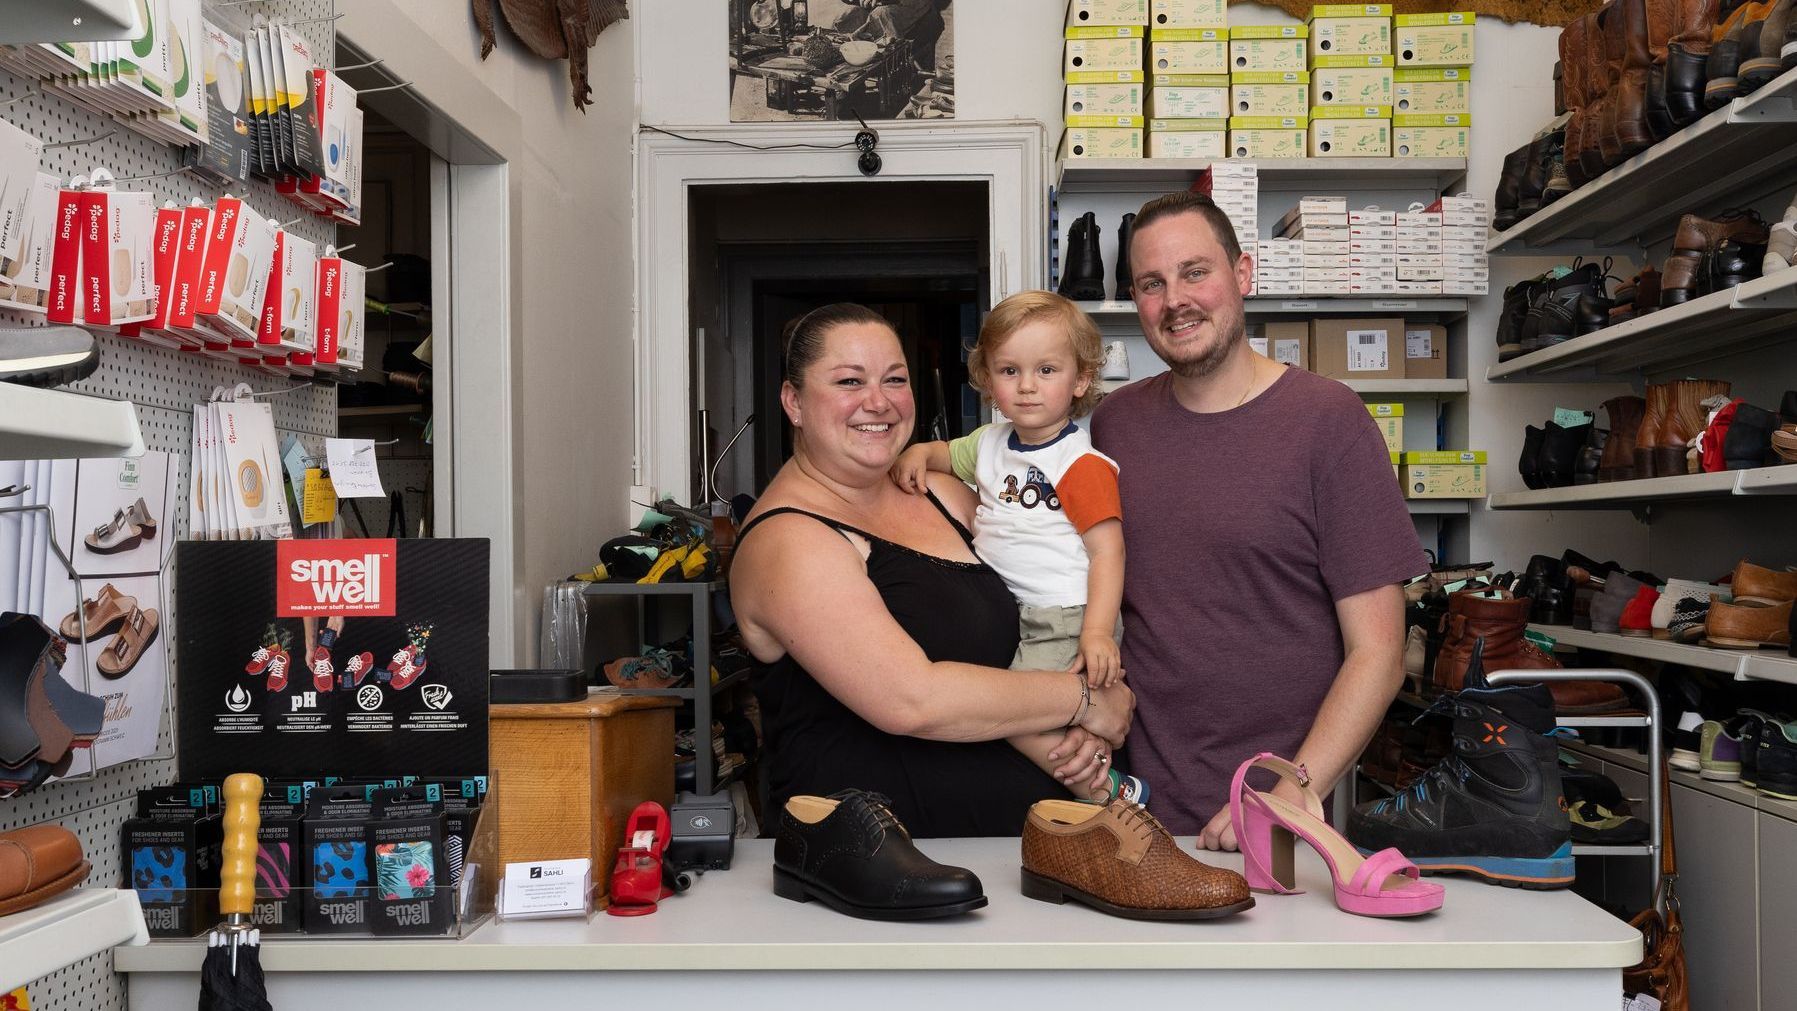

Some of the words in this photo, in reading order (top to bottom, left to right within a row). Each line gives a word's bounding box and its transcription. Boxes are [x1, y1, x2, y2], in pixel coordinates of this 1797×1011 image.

[0, 209, 13, 250] perfect
[62, 207, 73, 239] pedag
[89, 208, 100, 241] pedag
[187, 221, 198, 252] pedag
[217, 212, 229, 240] pedag
[159, 223, 170, 254] pedag
[34, 246, 42, 283] perfect
[57, 274, 66, 311] perfect
[90, 276, 101, 313] perfect
[205, 270, 217, 303] perfect
[325, 270, 333, 298] pedag
[178, 283, 189, 316] perfect
[266, 306, 274, 334] t-form
[291, 554, 380, 582] smell
[311, 580, 380, 604] well
[291, 691, 317, 712] pH
[193, 792, 200, 803] 2
[292, 789, 298, 800] 2
[430, 788, 436, 798] 2
[465, 783, 471, 794] 2
[407, 825, 431, 833] INSERTS
[320, 900, 364, 915] smell
[330, 913, 364, 925] well
[386, 901, 430, 916] smell
[395, 913, 430, 926] well
